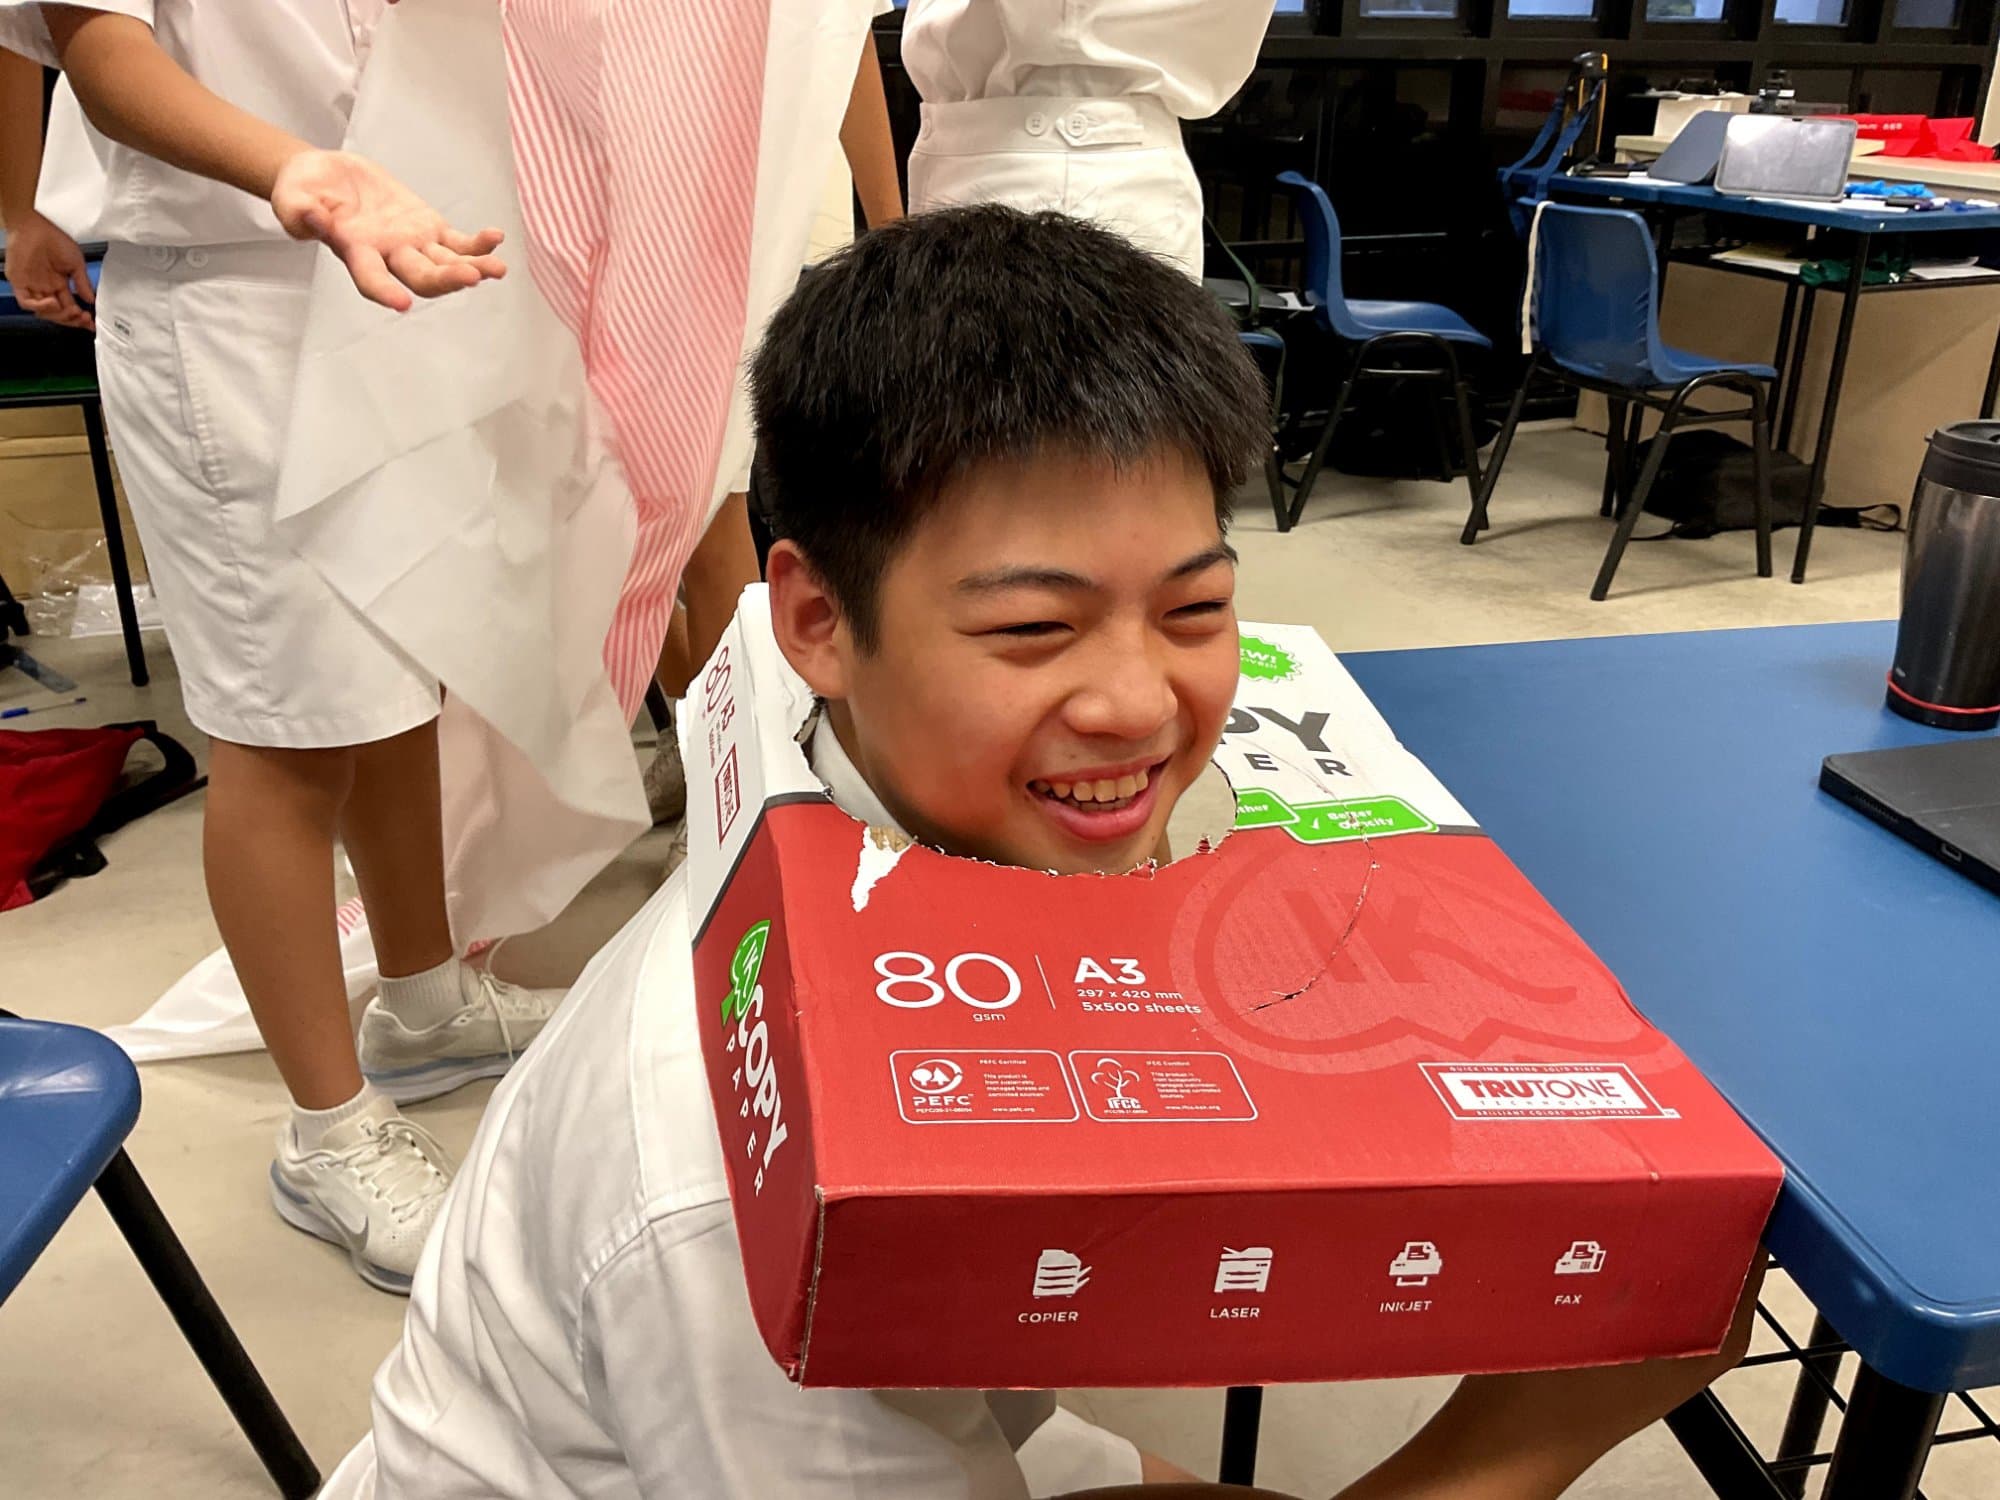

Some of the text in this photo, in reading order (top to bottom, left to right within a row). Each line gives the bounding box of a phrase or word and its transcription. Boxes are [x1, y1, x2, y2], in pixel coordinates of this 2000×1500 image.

[1074, 956, 1146, 985] A3
[873, 951, 1022, 1010] 80
[1077, 989, 1104, 998] 297
[1121, 990, 1151, 999] 420
[1154, 992, 1183, 1000] mm
[1082, 1001, 1202, 1014] 5x500 sheets
[972, 1012, 1006, 1022] gsm
[738, 984, 788, 1170] COPY
[1460, 1079, 1622, 1099] TRUTONE
[912, 1095, 970, 1107] PEFC
[1107, 1098, 1142, 1109] IFCC
[726, 1033, 763, 1196] PAPER
[1554, 1294, 1582, 1305] FAX
[1379, 1300, 1433, 1313] INKJET
[1017, 1311, 1079, 1323] COPIER
[1210, 1307, 1260, 1319] LASER
